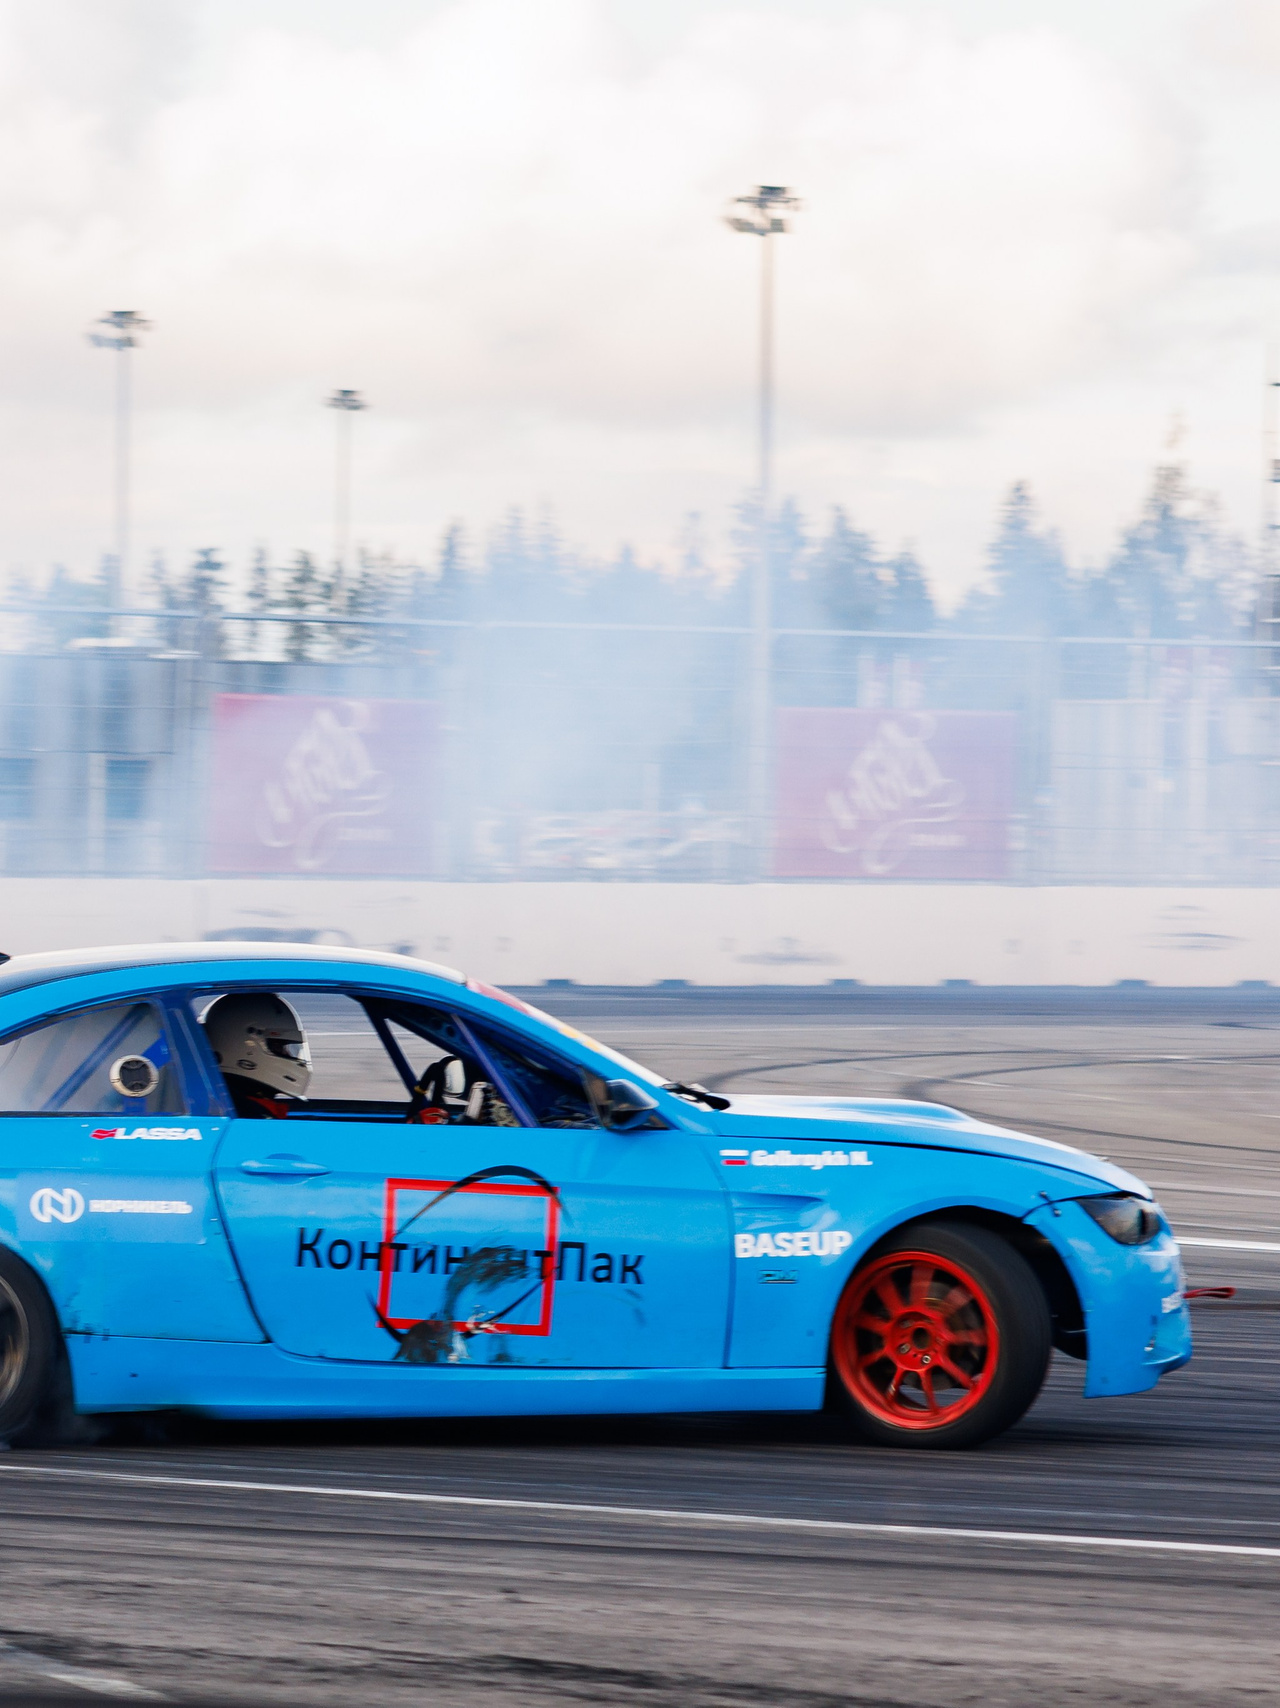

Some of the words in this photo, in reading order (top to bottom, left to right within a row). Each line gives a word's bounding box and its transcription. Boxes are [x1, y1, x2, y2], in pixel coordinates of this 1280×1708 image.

[114, 1127, 203, 1141] LASSA
[295, 1227, 645, 1285] КонтиннтПак
[734, 1230, 853, 1258] BASEUP
